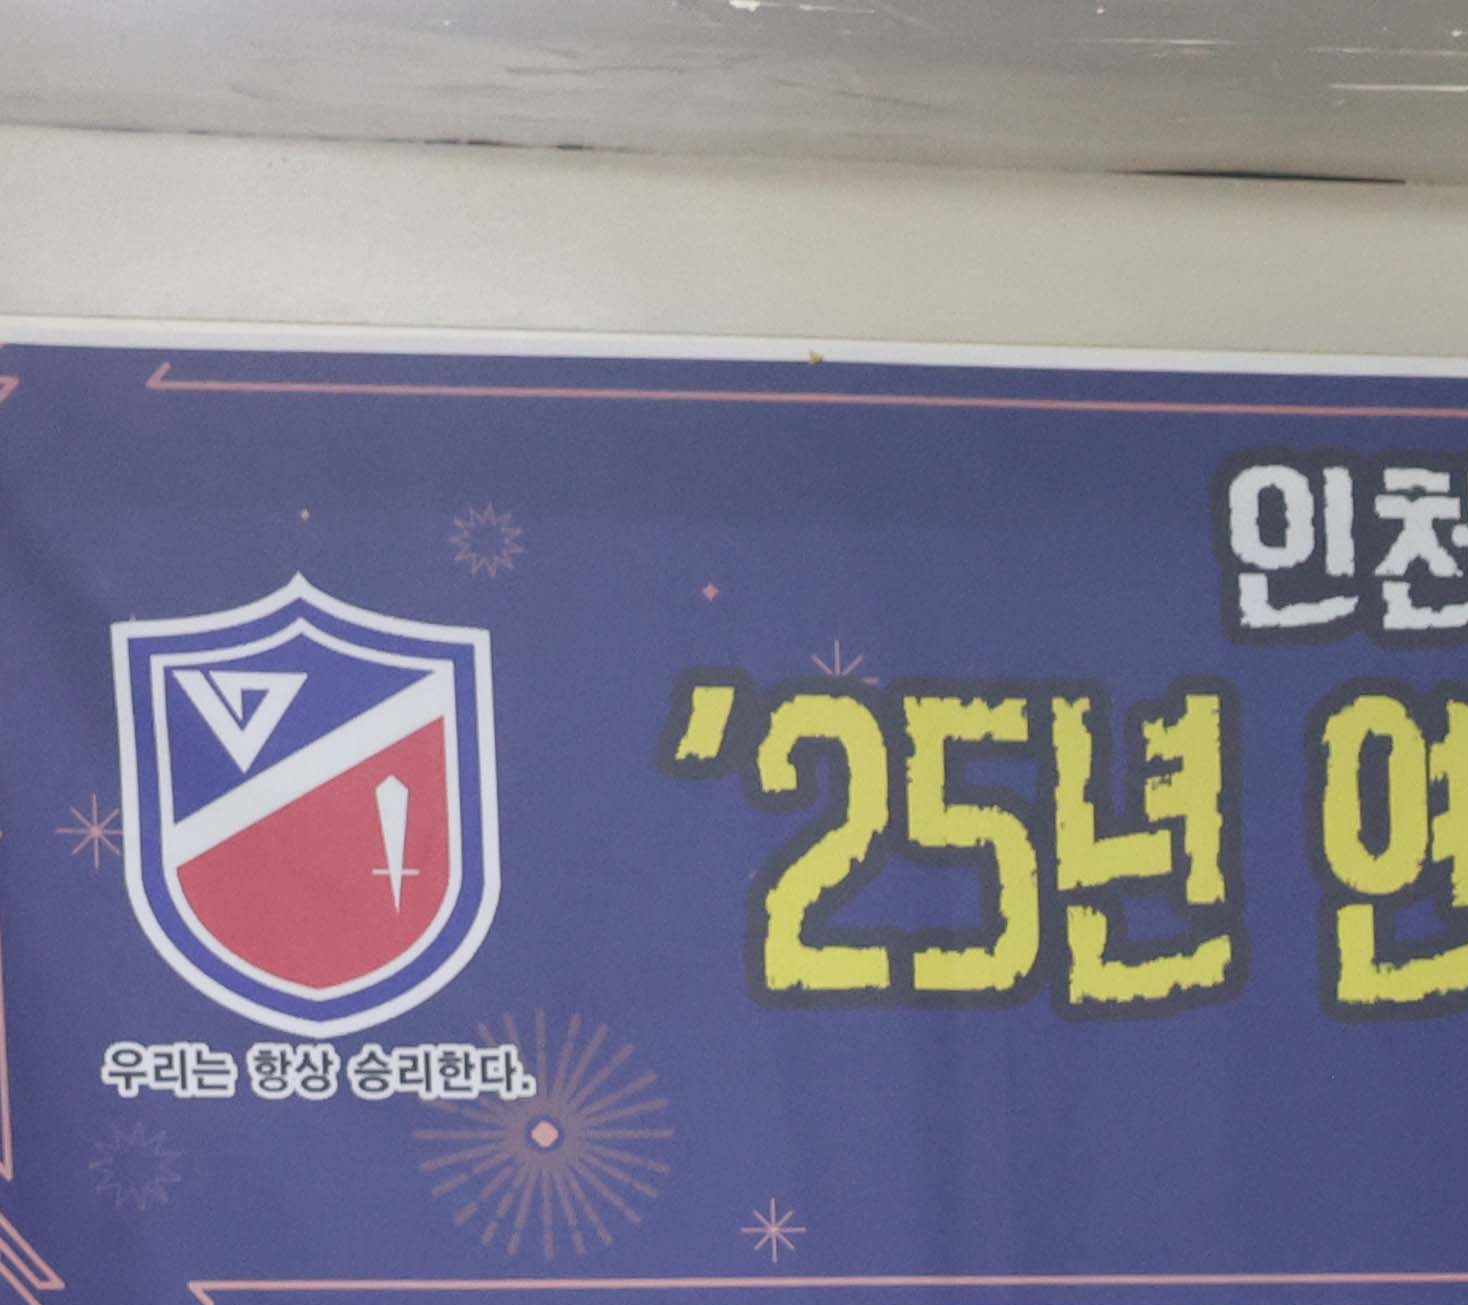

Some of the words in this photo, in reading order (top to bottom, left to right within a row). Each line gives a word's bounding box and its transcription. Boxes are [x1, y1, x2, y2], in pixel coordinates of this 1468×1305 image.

[106, 1045, 235, 1094] 우리는
[252, 1046, 335, 1095] 항상
[351, 1046, 533, 1096] 승리한다.
